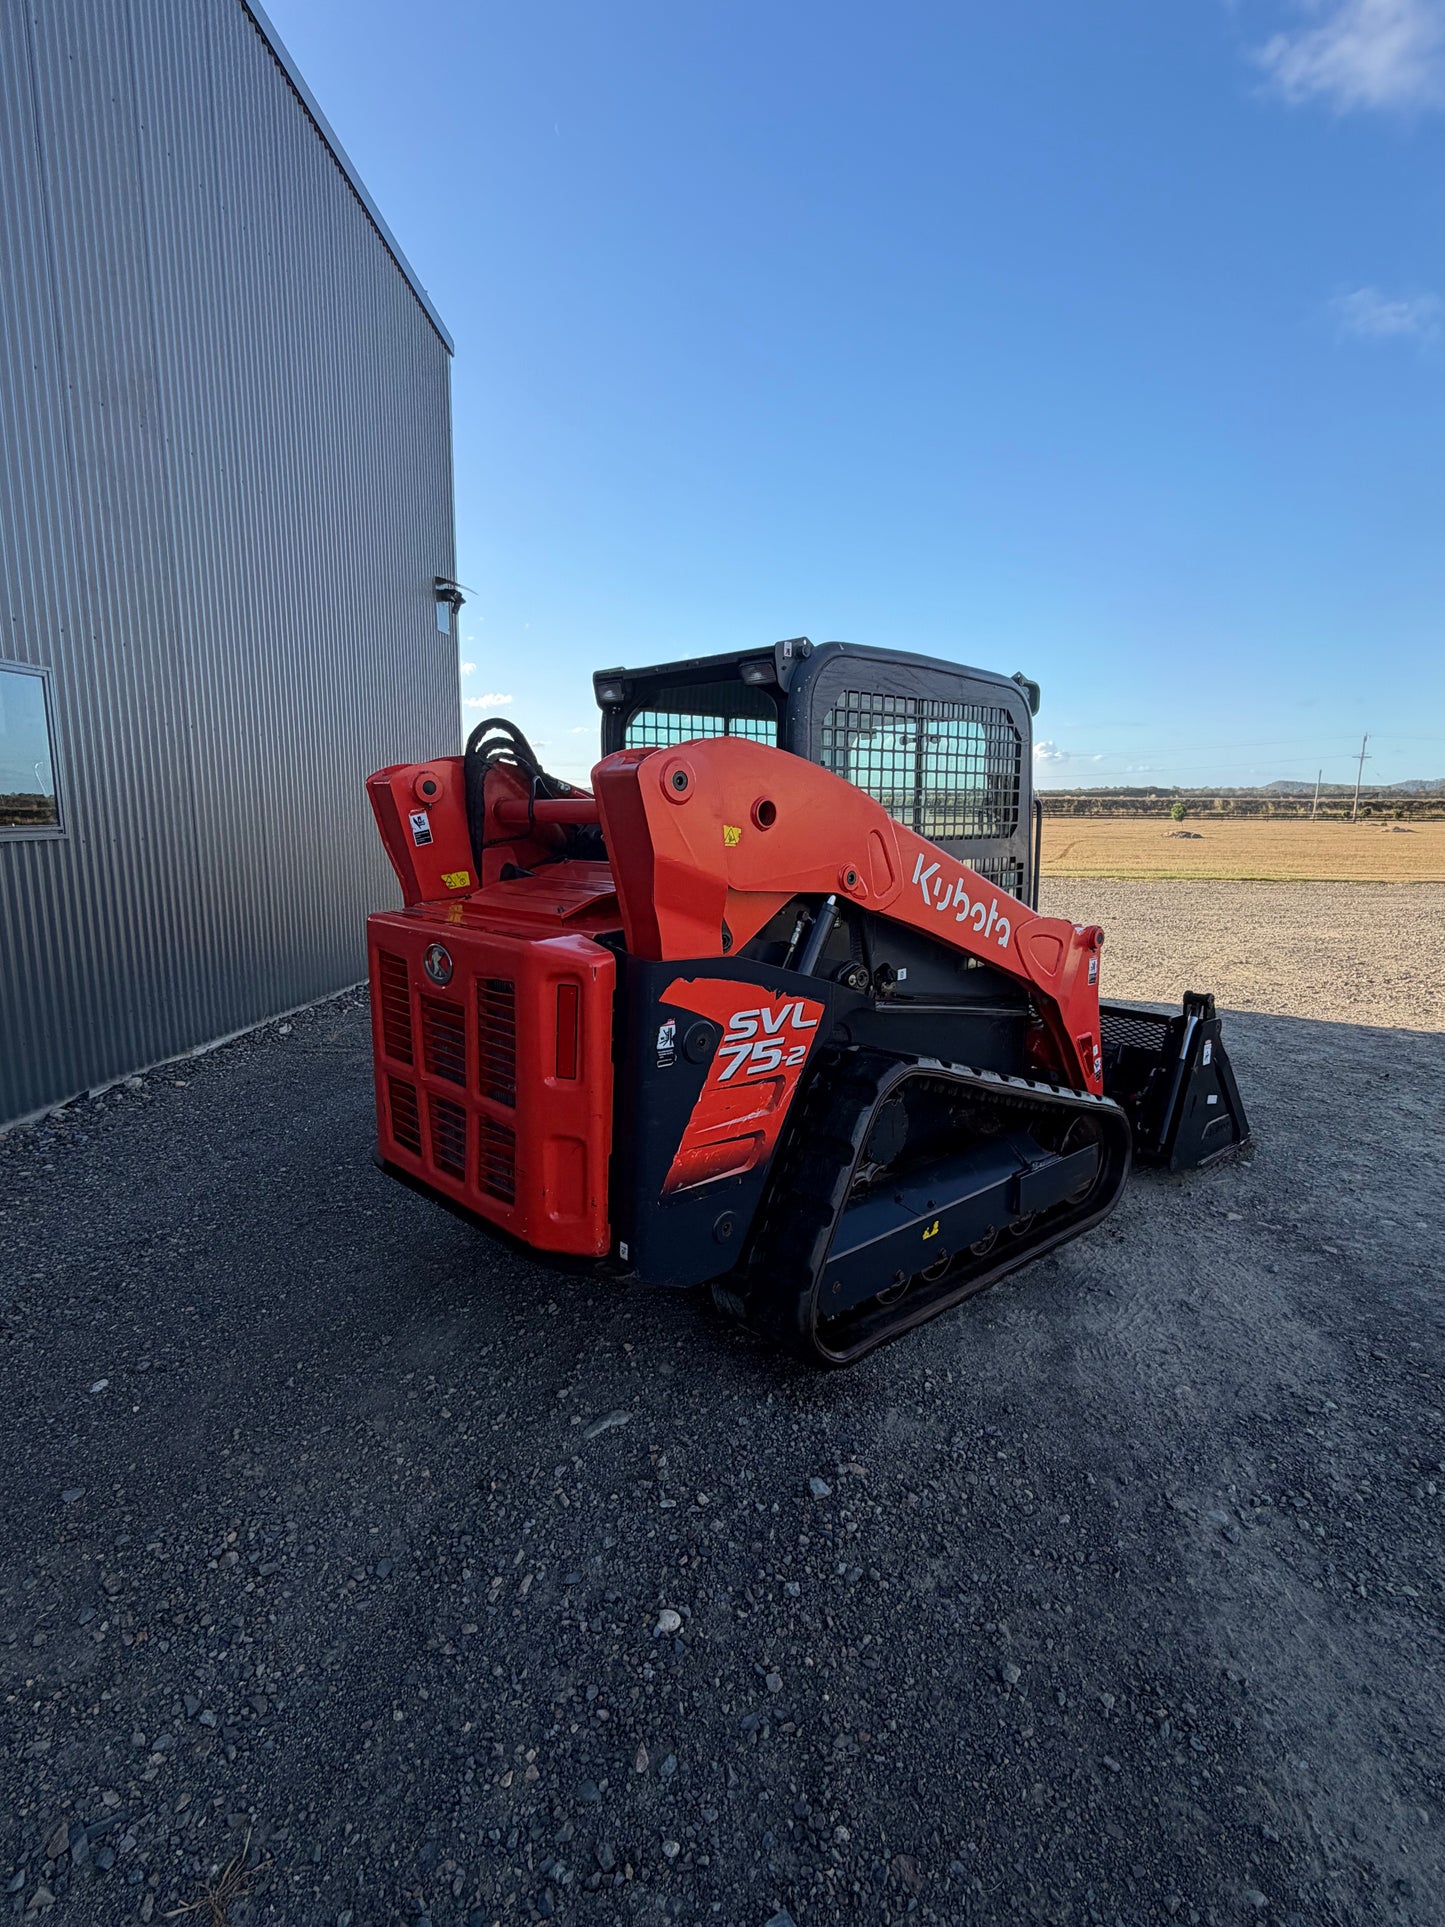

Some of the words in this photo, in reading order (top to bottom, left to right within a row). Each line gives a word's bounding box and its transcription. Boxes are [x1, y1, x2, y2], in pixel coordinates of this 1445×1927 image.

[911, 852, 1011, 949] Kubota
[723, 1001, 818, 1042] SVL
[717, 1036, 806, 1082] 75-2
